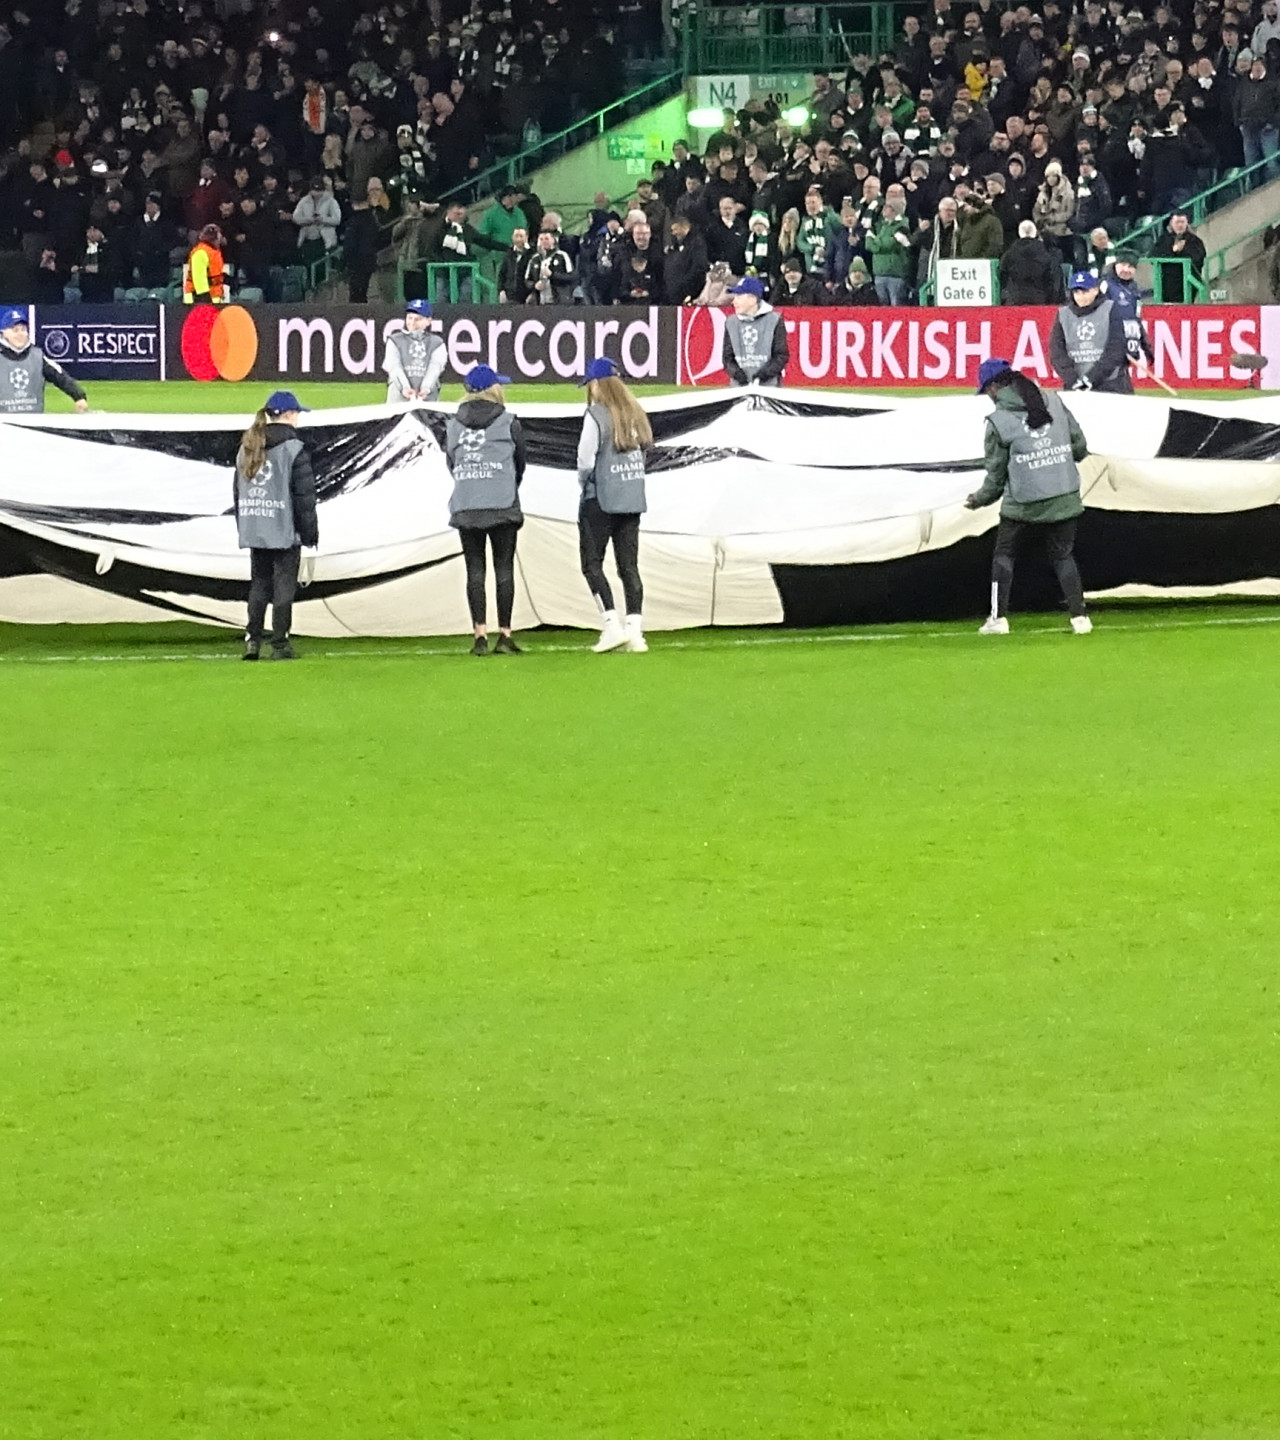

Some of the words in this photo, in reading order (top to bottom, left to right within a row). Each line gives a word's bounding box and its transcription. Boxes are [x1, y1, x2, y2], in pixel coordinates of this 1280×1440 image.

[709, 81, 737, 107] N4
[951, 267, 977, 281] Exit
[943, 286, 974, 300] Gate
[978, 286, 987, 300] 6
[78, 333, 157, 355] RESPECT
[277, 305, 660, 378] maercard
[1016, 444, 1072, 464] CHAMPIONS
[1028, 455, 1067, 470] LEAGUE
[455, 470, 493, 481] LEAGUE
[240, 508, 276, 519] LEAGUE
